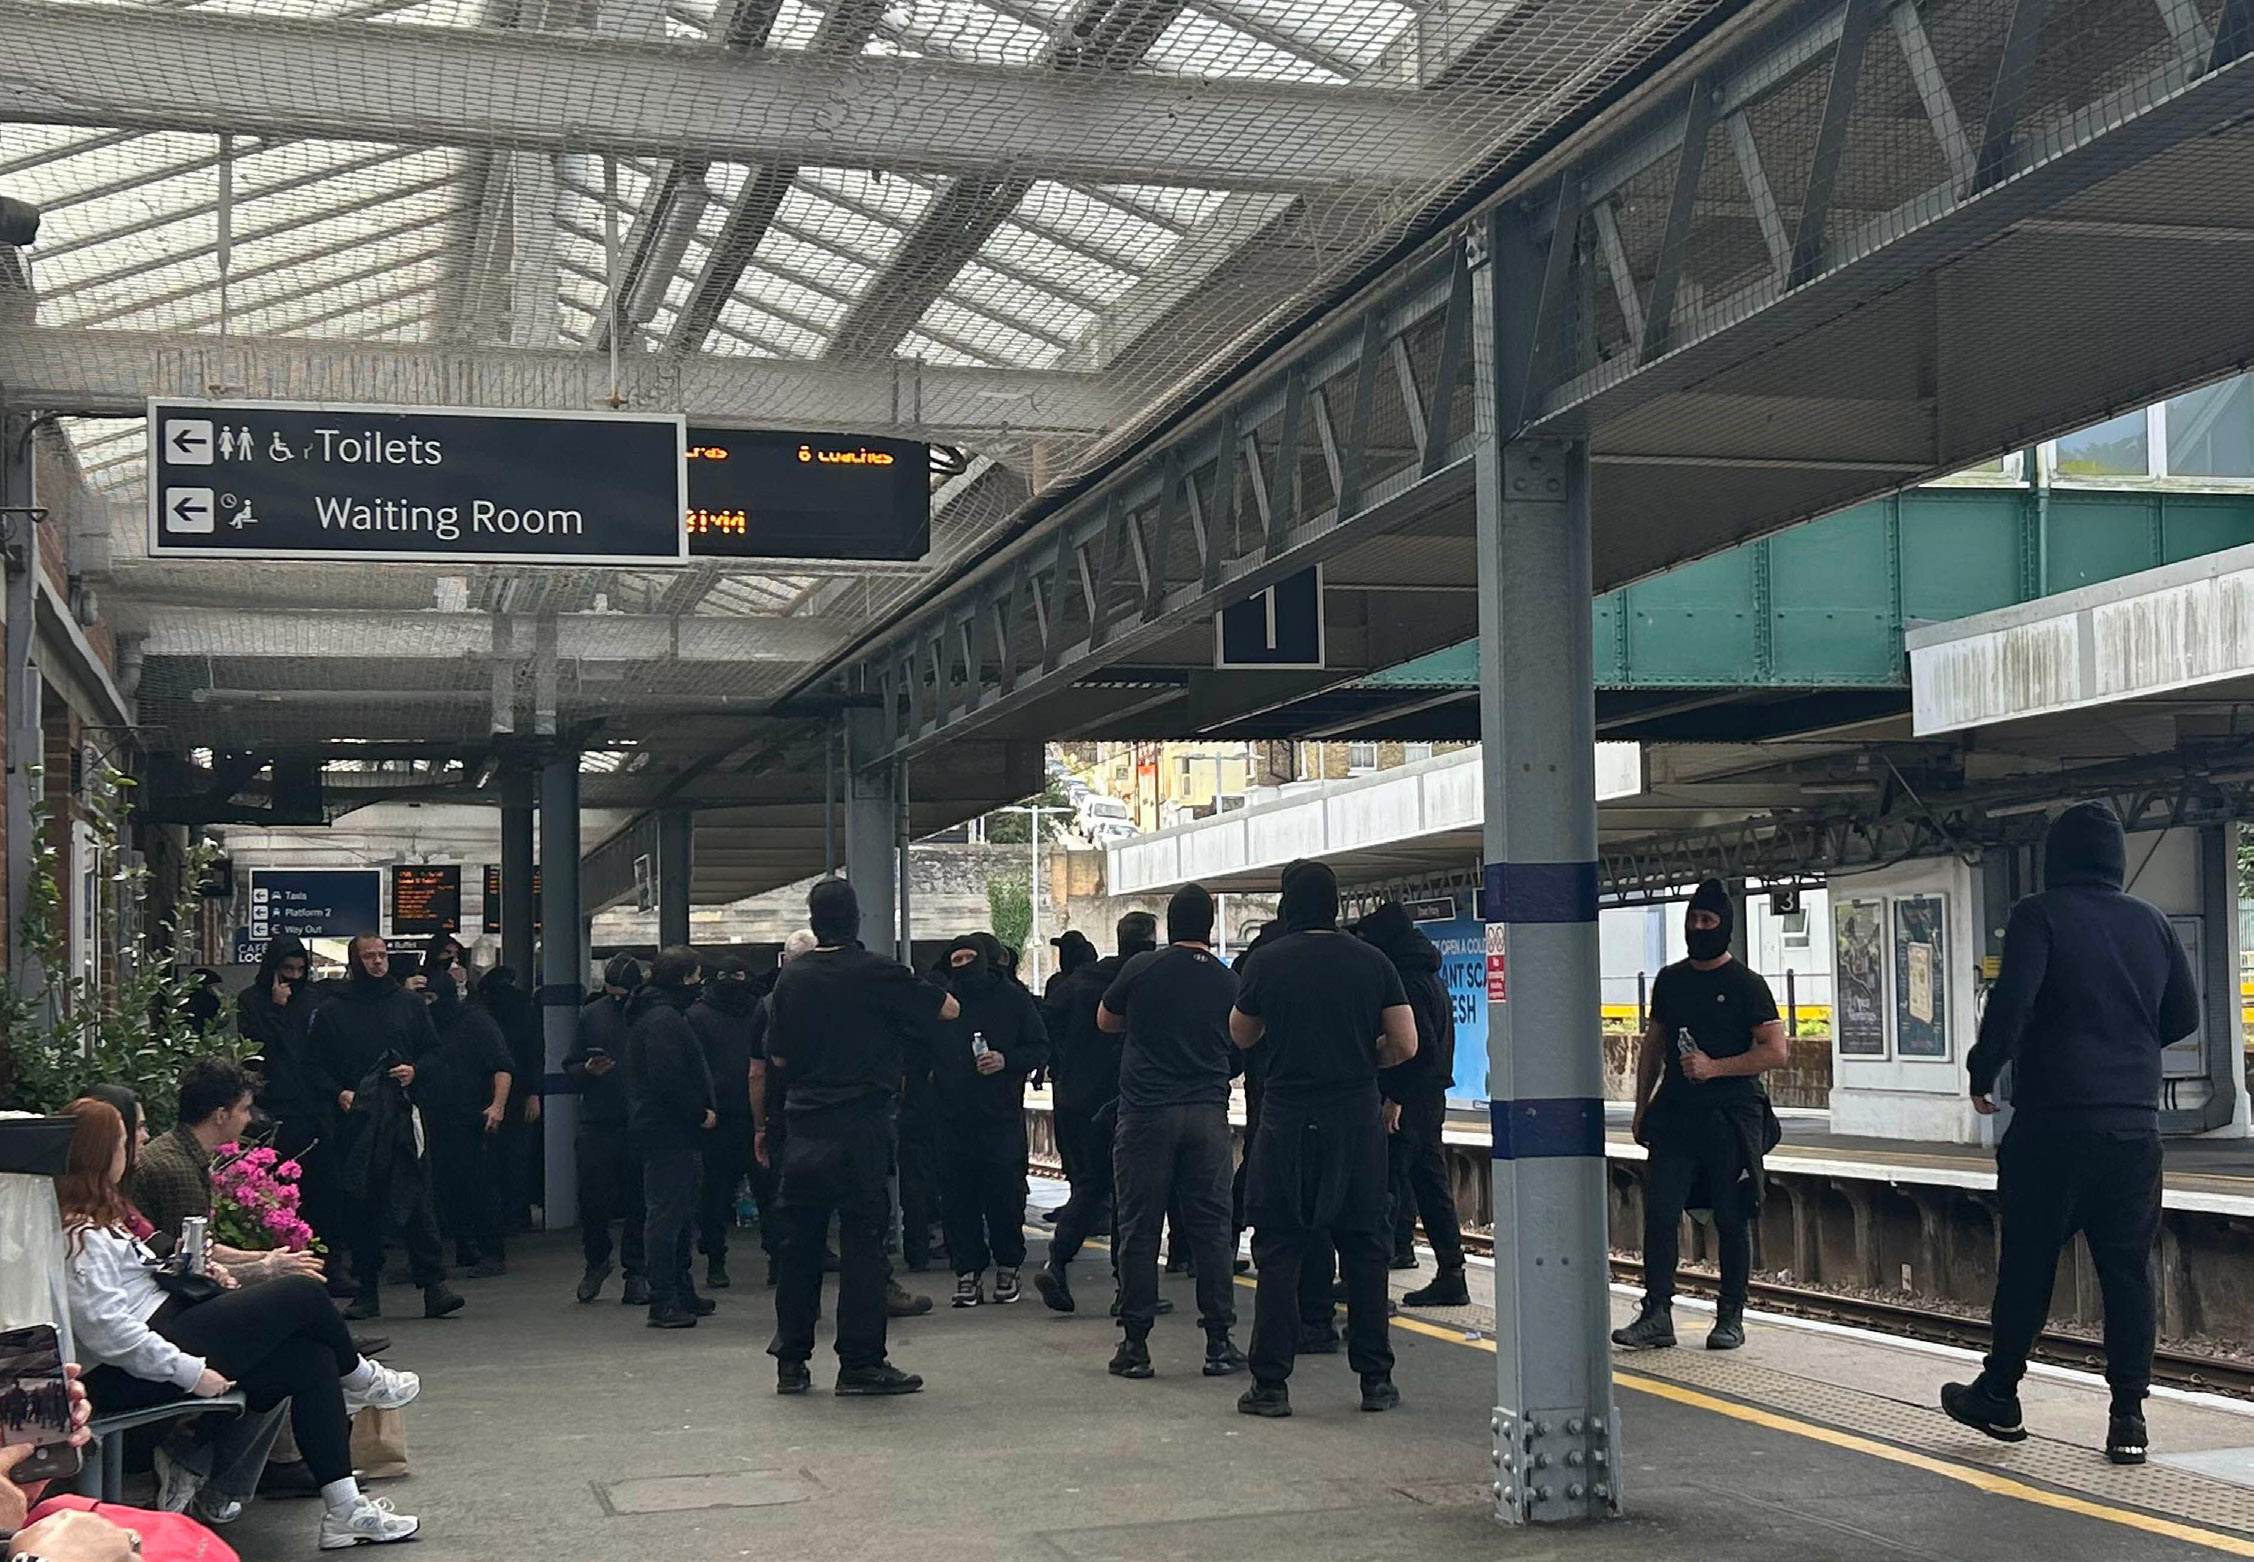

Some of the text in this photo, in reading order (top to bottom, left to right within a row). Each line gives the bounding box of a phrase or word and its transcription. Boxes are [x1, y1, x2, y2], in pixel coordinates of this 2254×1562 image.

[314, 429, 442, 465] Toilets
[314, 496, 583, 540] Waiting Room
[1249, 585, 1276, 649] 1
[285, 891, 307, 900] Taxis
[1780, 892, 1794, 911] 3
[285, 908, 332, 917] Platform 2
[284, 925, 322, 935] Way Out
